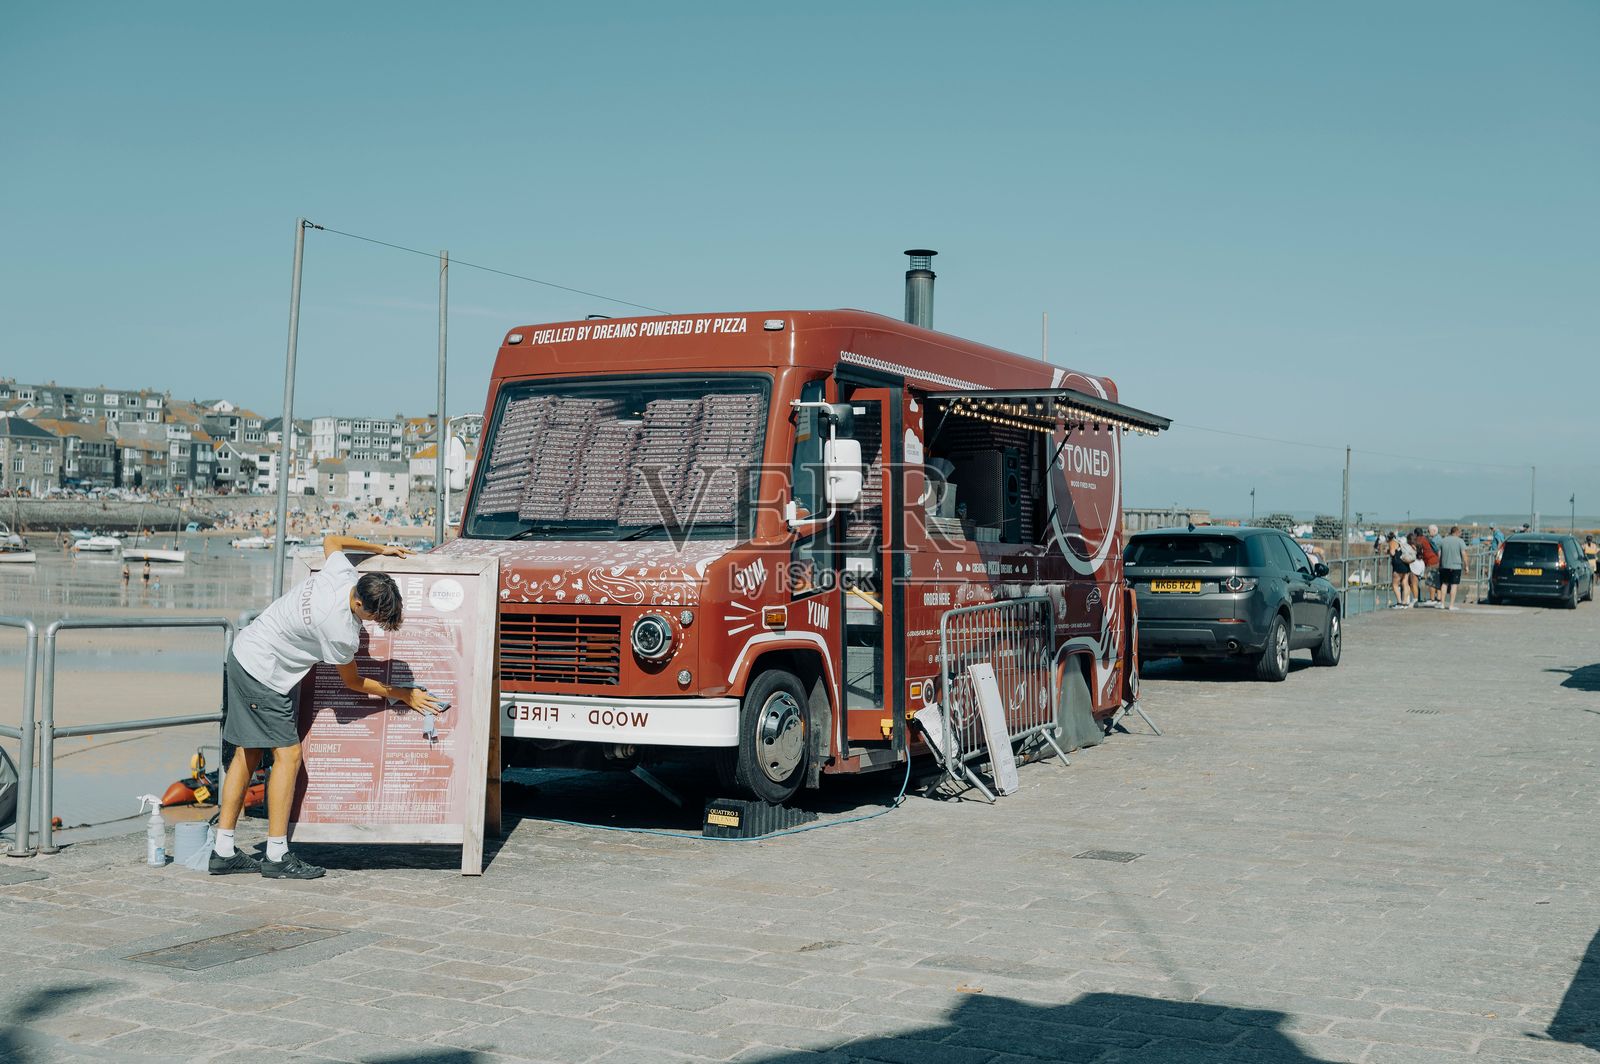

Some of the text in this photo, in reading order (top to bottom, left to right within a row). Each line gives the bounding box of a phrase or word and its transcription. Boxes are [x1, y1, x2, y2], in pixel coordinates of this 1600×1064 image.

[532, 317, 748, 345] FUELLED BY DREAMS POWERED BY PIZZA
[1056, 441, 1110, 478] STONED
[735, 557, 767, 596] YUM
[1155, 580, 1177, 590] WK66
[1180, 580, 1197, 590] RZA
[301, 577, 316, 626] STONED
[407, 577, 424, 611] MENU
[807, 600, 830, 630] YUM
[309, 743, 342, 753] GOURMET
[709, 808, 735, 816] QUATTRO
